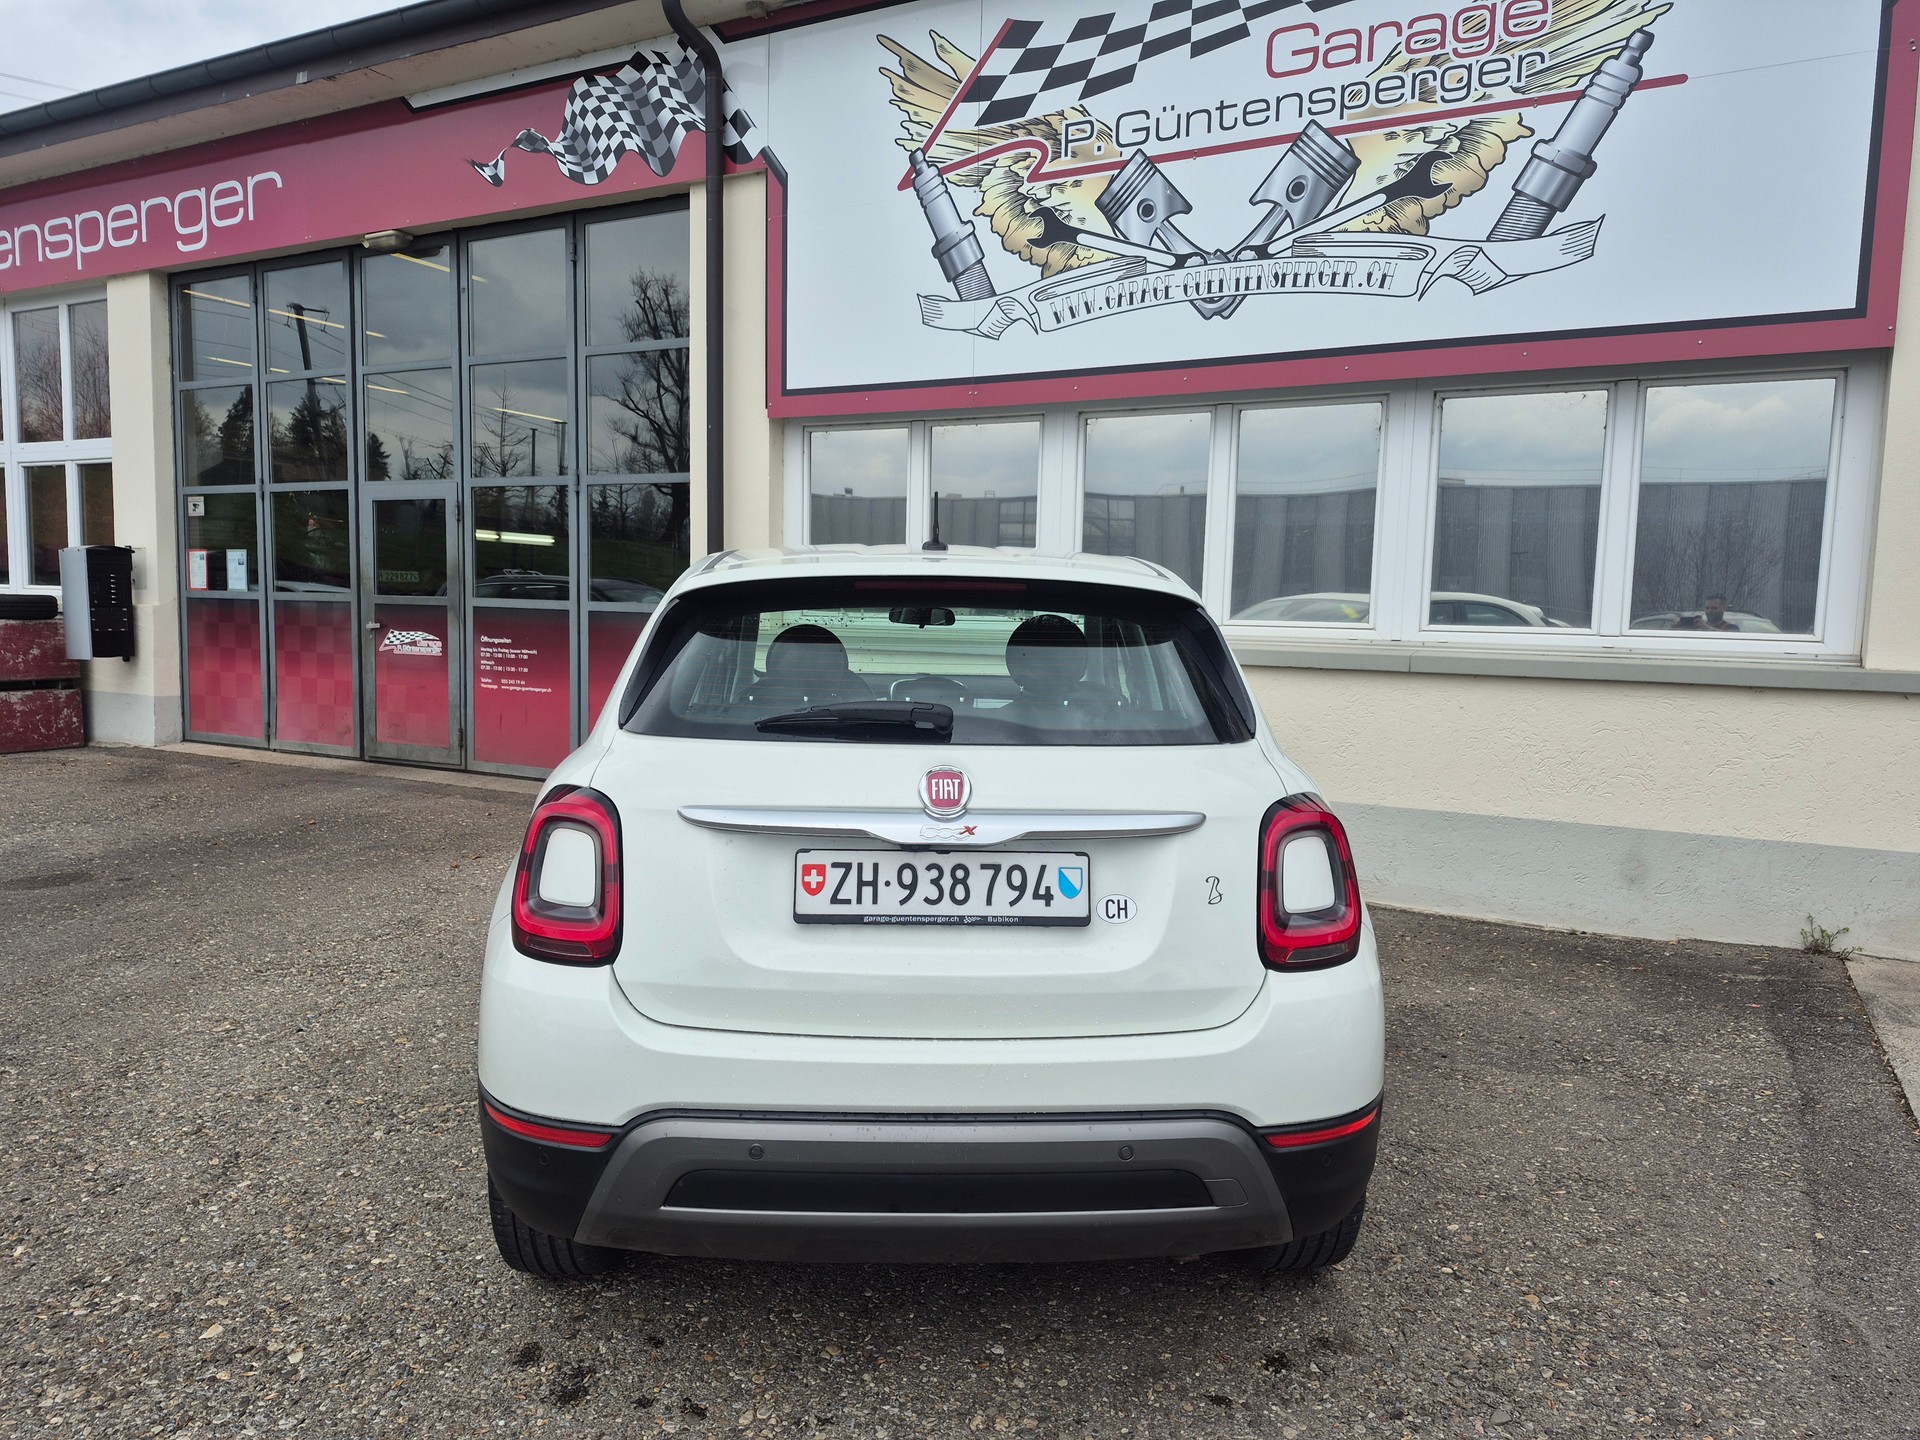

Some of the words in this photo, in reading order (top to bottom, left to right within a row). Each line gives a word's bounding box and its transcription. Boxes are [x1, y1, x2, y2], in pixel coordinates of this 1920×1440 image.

[1265, 0, 1550, 79] Garage
[1063, 121, 1103, 158] P.
[1114, 48, 1546, 148] Güntensperger
[1049, 259, 1398, 325] WWW.GARAGE-GUENTENSPERGER.CH
[931, 778, 961, 800] FIAT
[863, 915, 960, 923] garage-guentensperger.ch
[1105, 898, 1129, 920] CH
